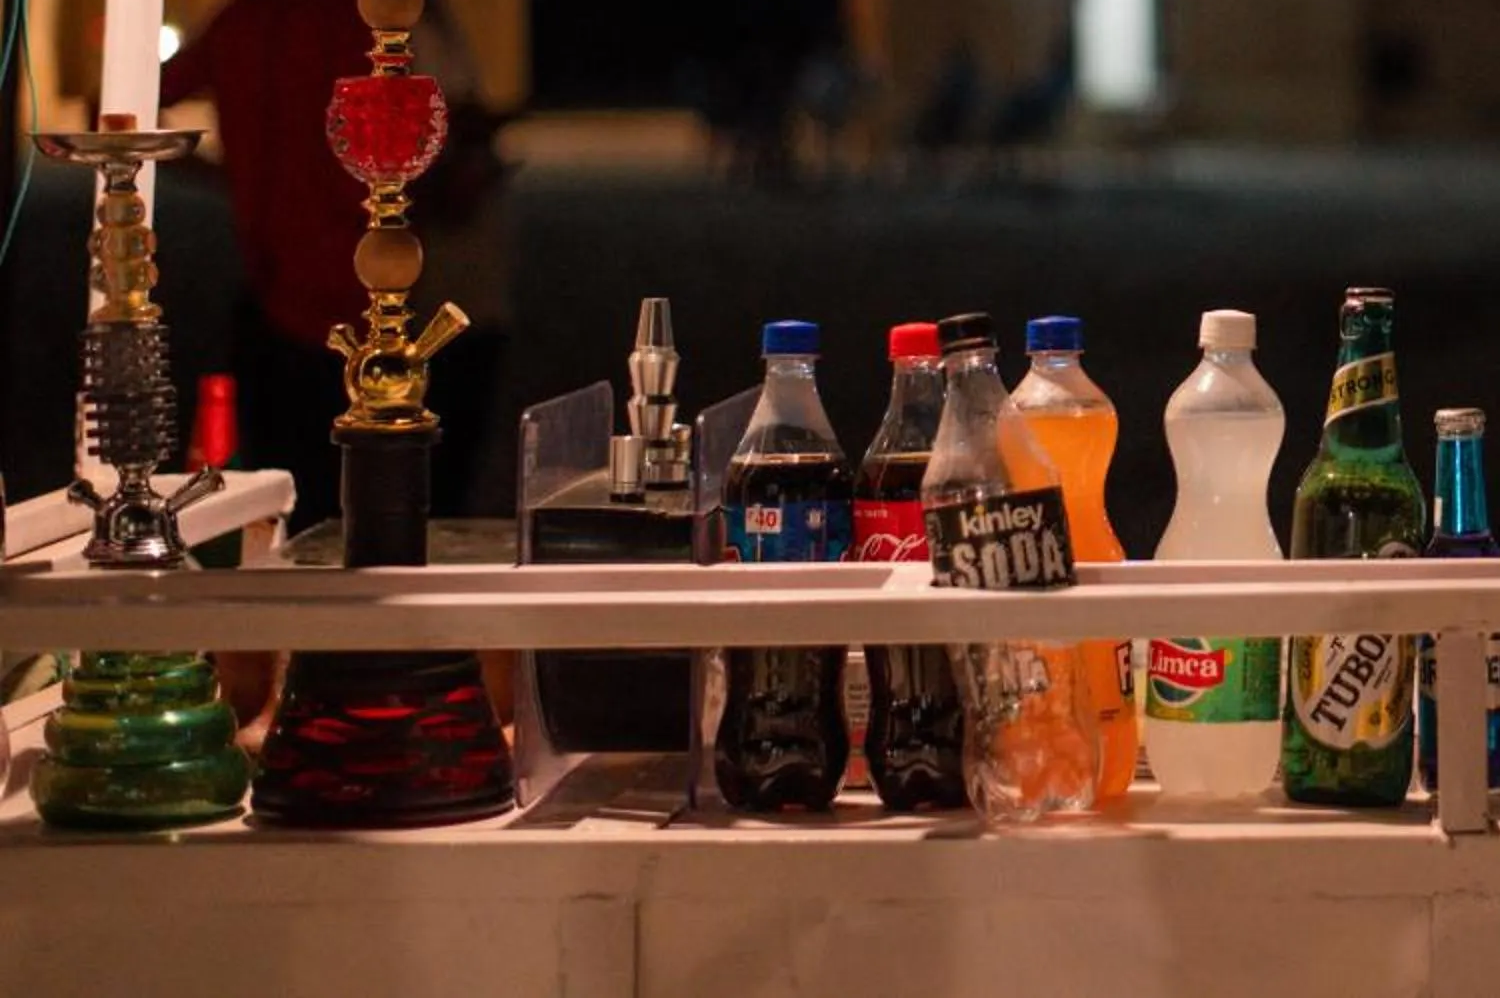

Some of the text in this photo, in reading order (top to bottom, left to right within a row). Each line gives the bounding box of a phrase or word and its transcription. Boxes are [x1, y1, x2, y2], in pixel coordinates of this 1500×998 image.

[1331, 368, 1395, 404] STRONG
[960, 503, 1043, 539] kinley
[952, 527, 1067, 589] SODA
[1151, 647, 1219, 678] Limca
[1310, 634, 1392, 732] TUBO
